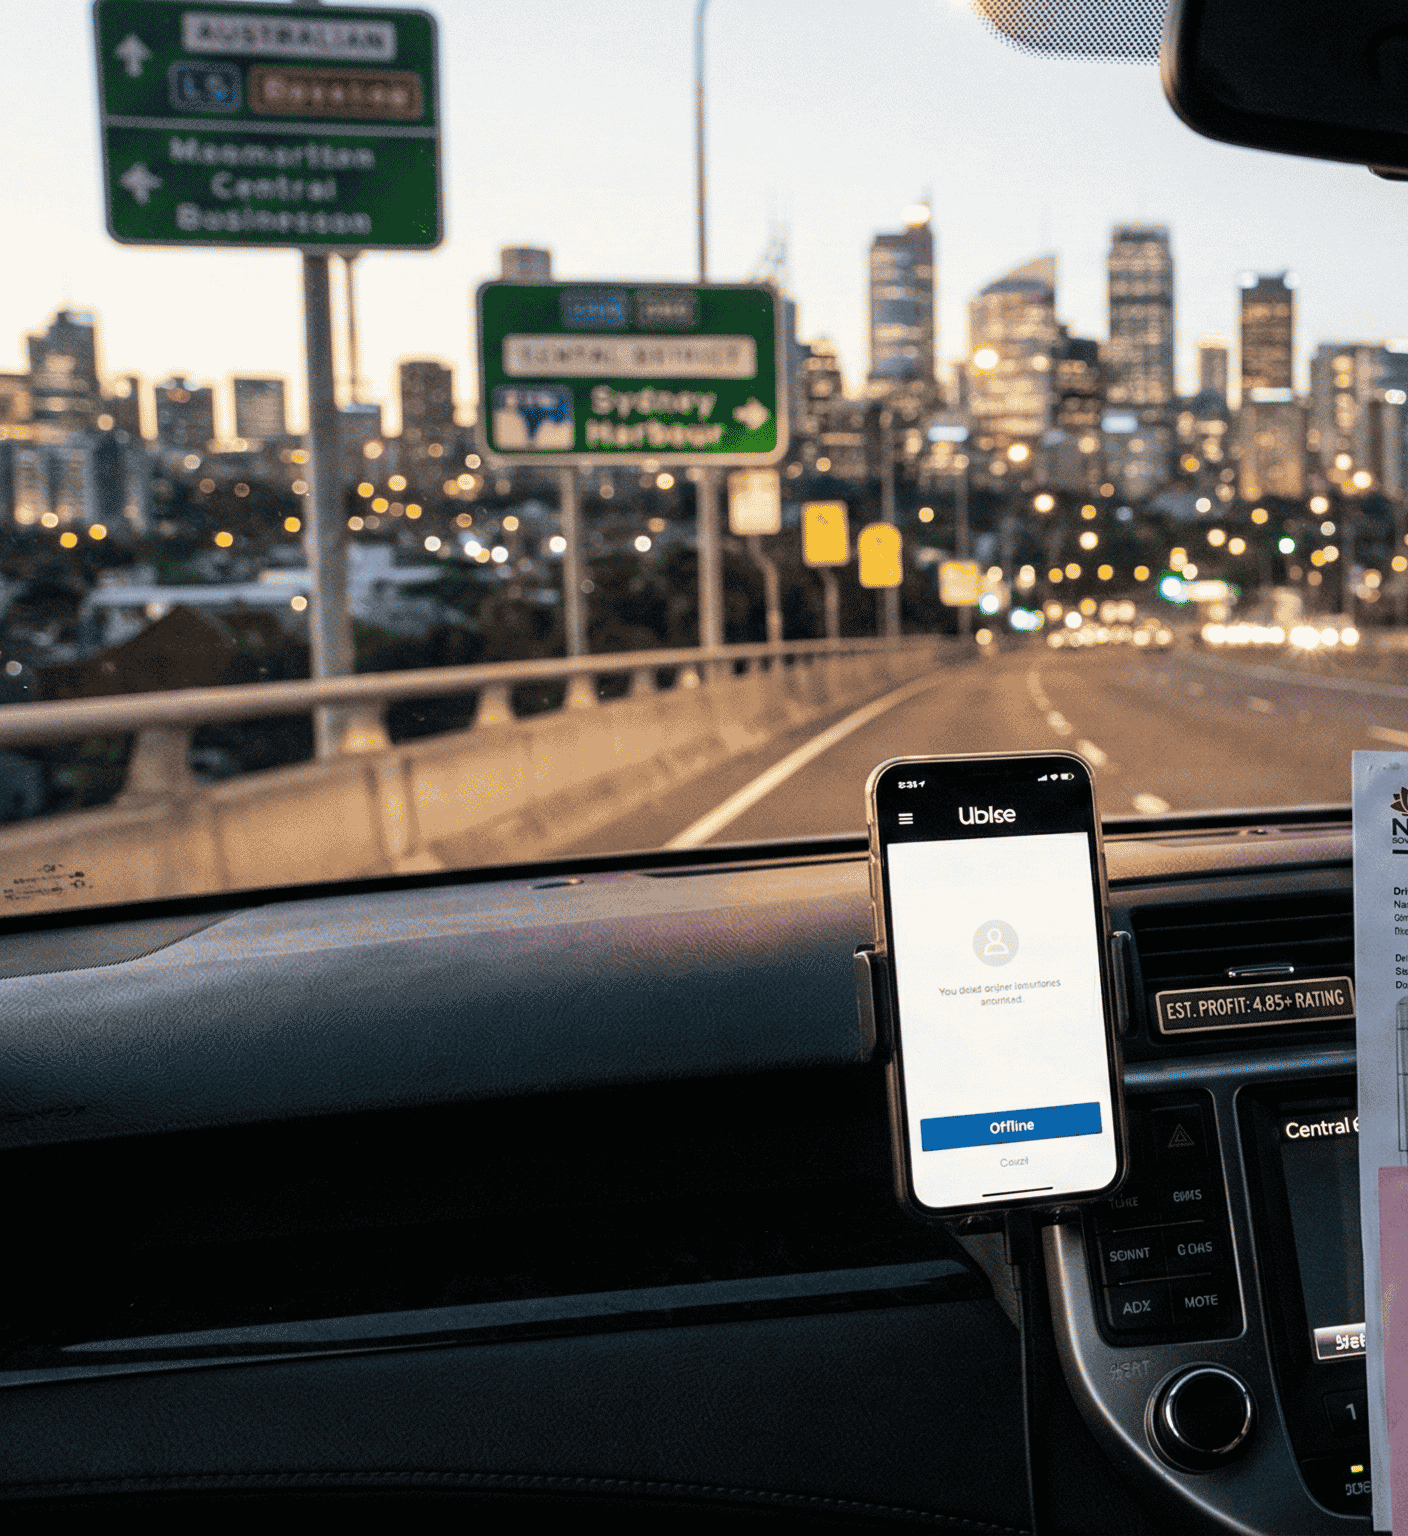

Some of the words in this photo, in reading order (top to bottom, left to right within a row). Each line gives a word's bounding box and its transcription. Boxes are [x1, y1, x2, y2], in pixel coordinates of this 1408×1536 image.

[210, 170, 338, 202] Central
[591, 385, 717, 421] Sydney
[585, 417, 725, 449] Harbour
[1166, 1001, 1197, 1020] EST.
[1199, 997, 1251, 1018] PROFIT:
[1252, 993, 1293, 1013] 4.85+
[1295, 989, 1345, 1009] RATING
[989, 1119, 1035, 1135] Offline
[1285, 1116, 1351, 1139] Central
[1184, 1294, 1219, 1309] MOTE
[1345, 1402, 1357, 1421] 1
